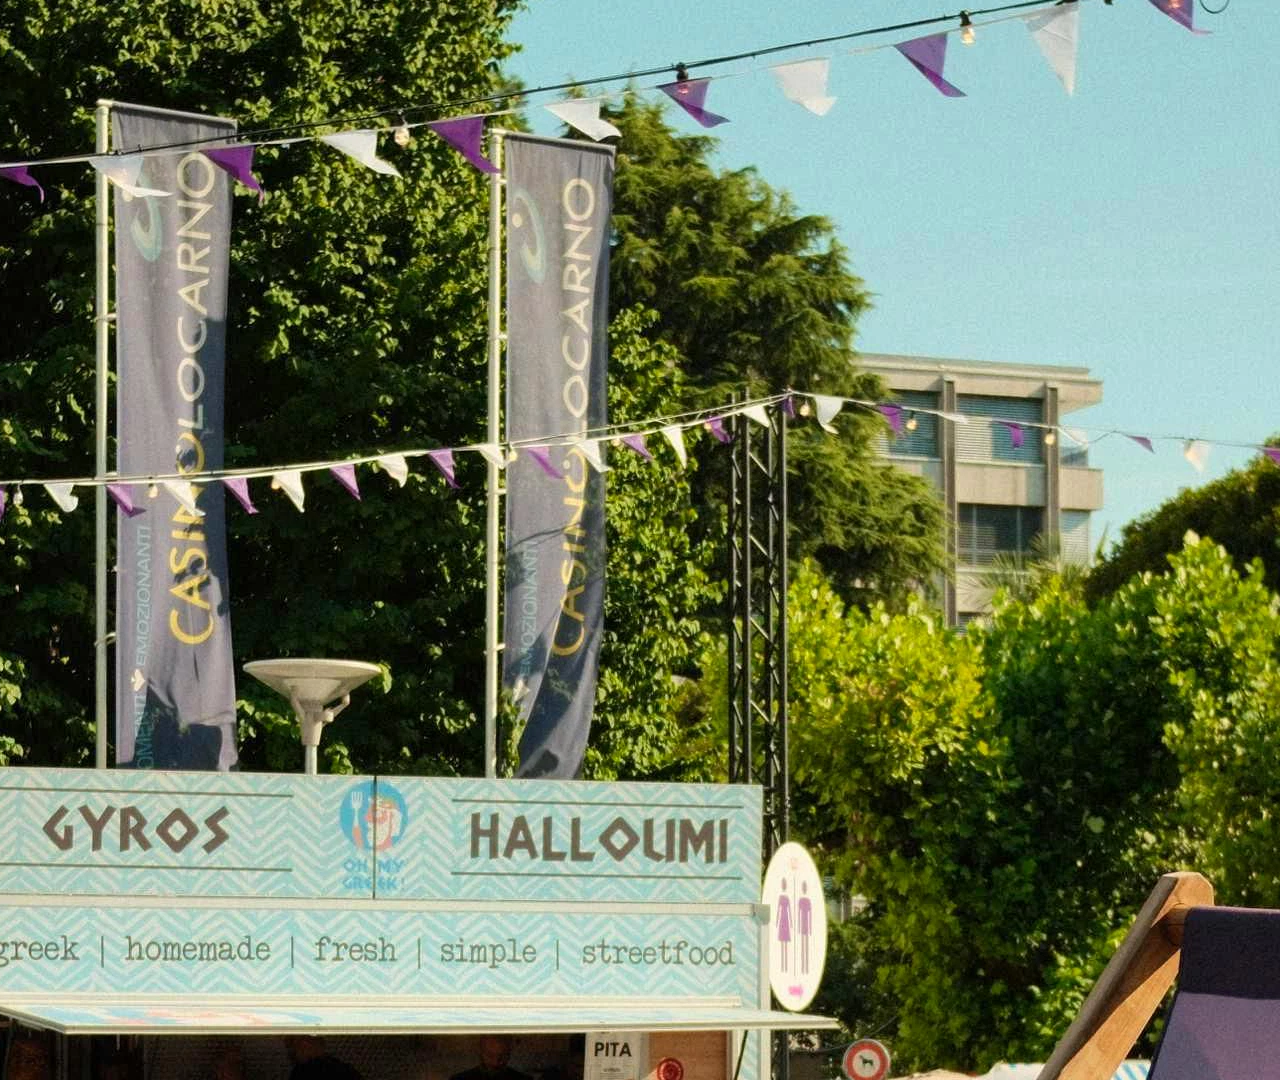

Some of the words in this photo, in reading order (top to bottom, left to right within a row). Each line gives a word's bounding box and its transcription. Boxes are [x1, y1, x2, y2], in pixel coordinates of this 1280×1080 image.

[42, 804, 231, 854] GYROS
[470, 811, 729, 864] HALLOUMI
[344, 859, 369, 872] OH
[379, 858, 404, 872] MY
[124, 936, 271, 962] homemade
[314, 936, 398, 963] fresh
[439, 938, 537, 969] simple
[581, 940, 736, 966] streetfood
[594, 1042, 632, 1058] PITA
